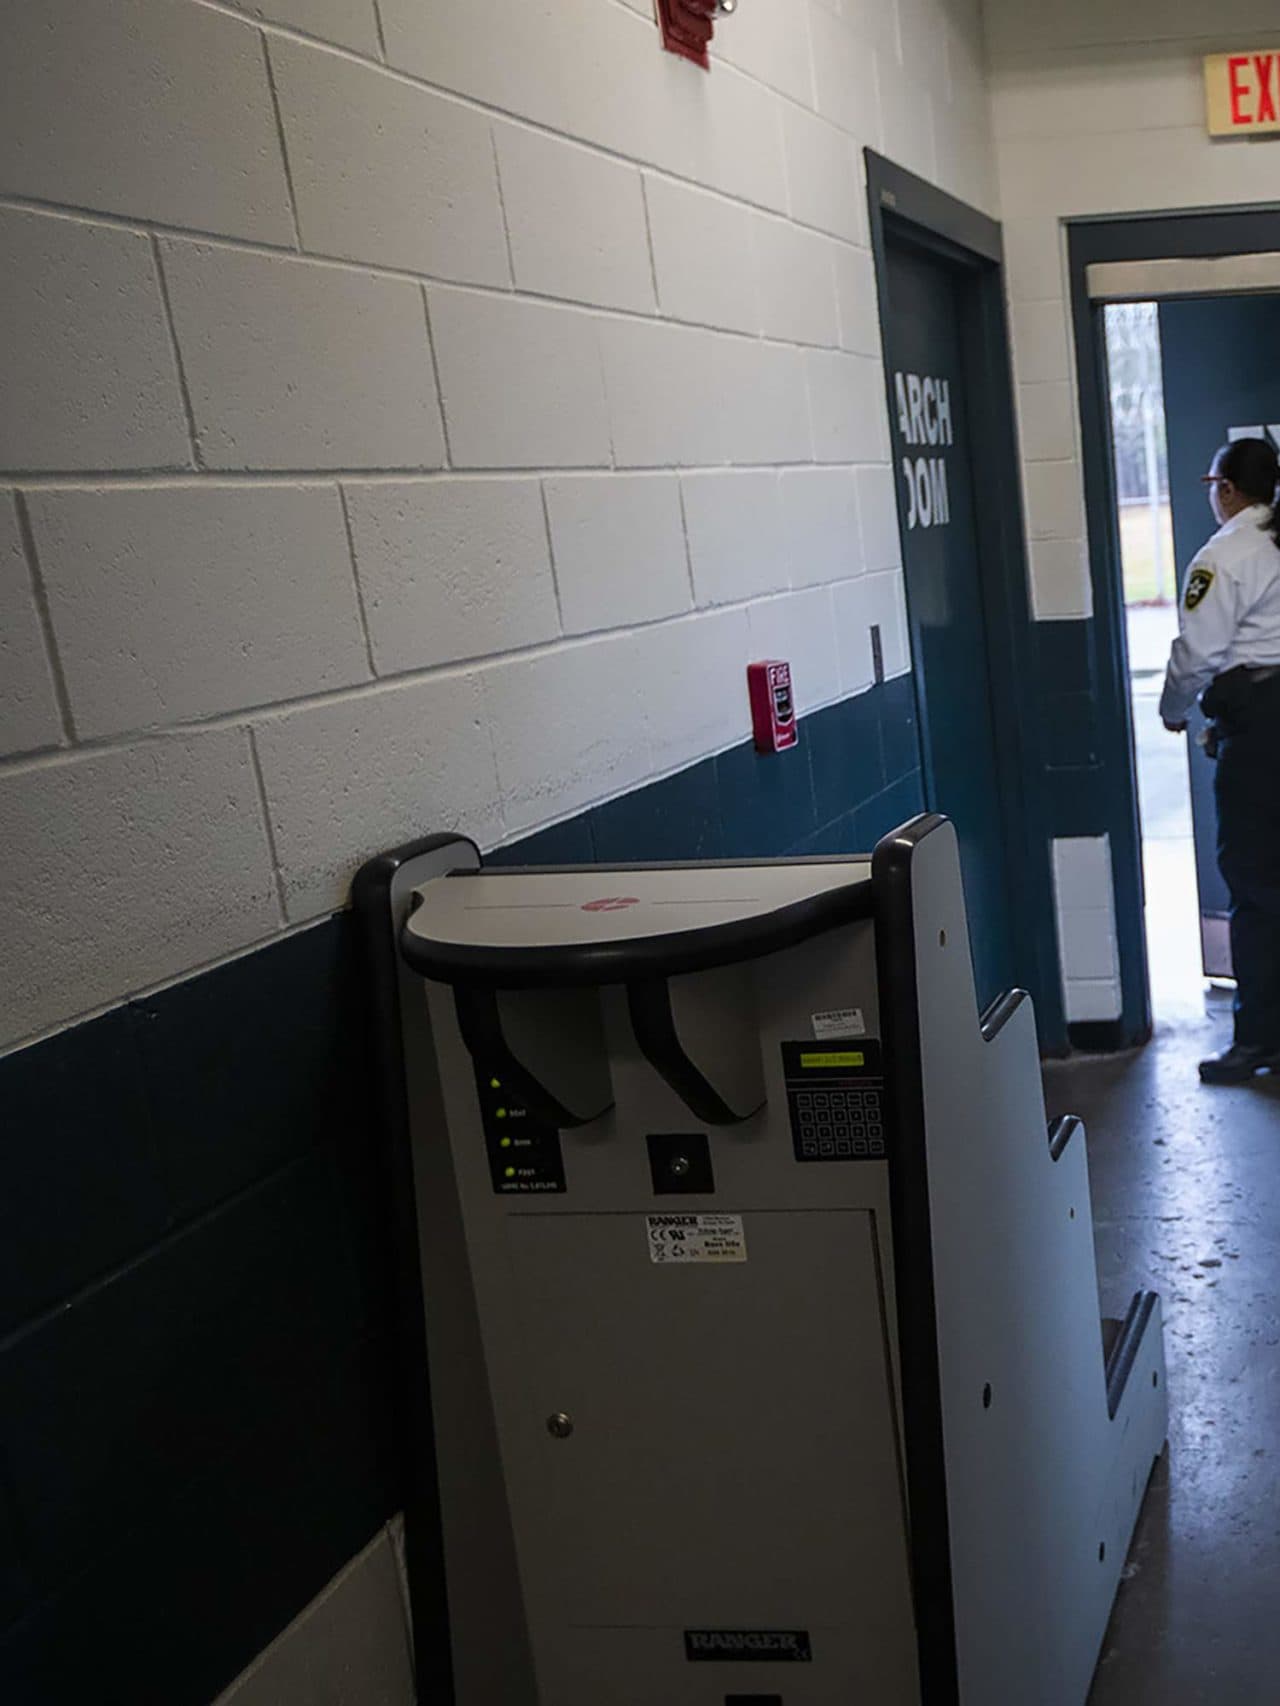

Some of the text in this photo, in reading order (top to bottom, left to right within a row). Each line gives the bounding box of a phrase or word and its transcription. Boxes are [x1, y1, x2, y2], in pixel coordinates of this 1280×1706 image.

[769, 664, 790, 686] FIRE
[648, 1215, 698, 1227] RANGER
[690, 1632, 799, 1649] RANGER
